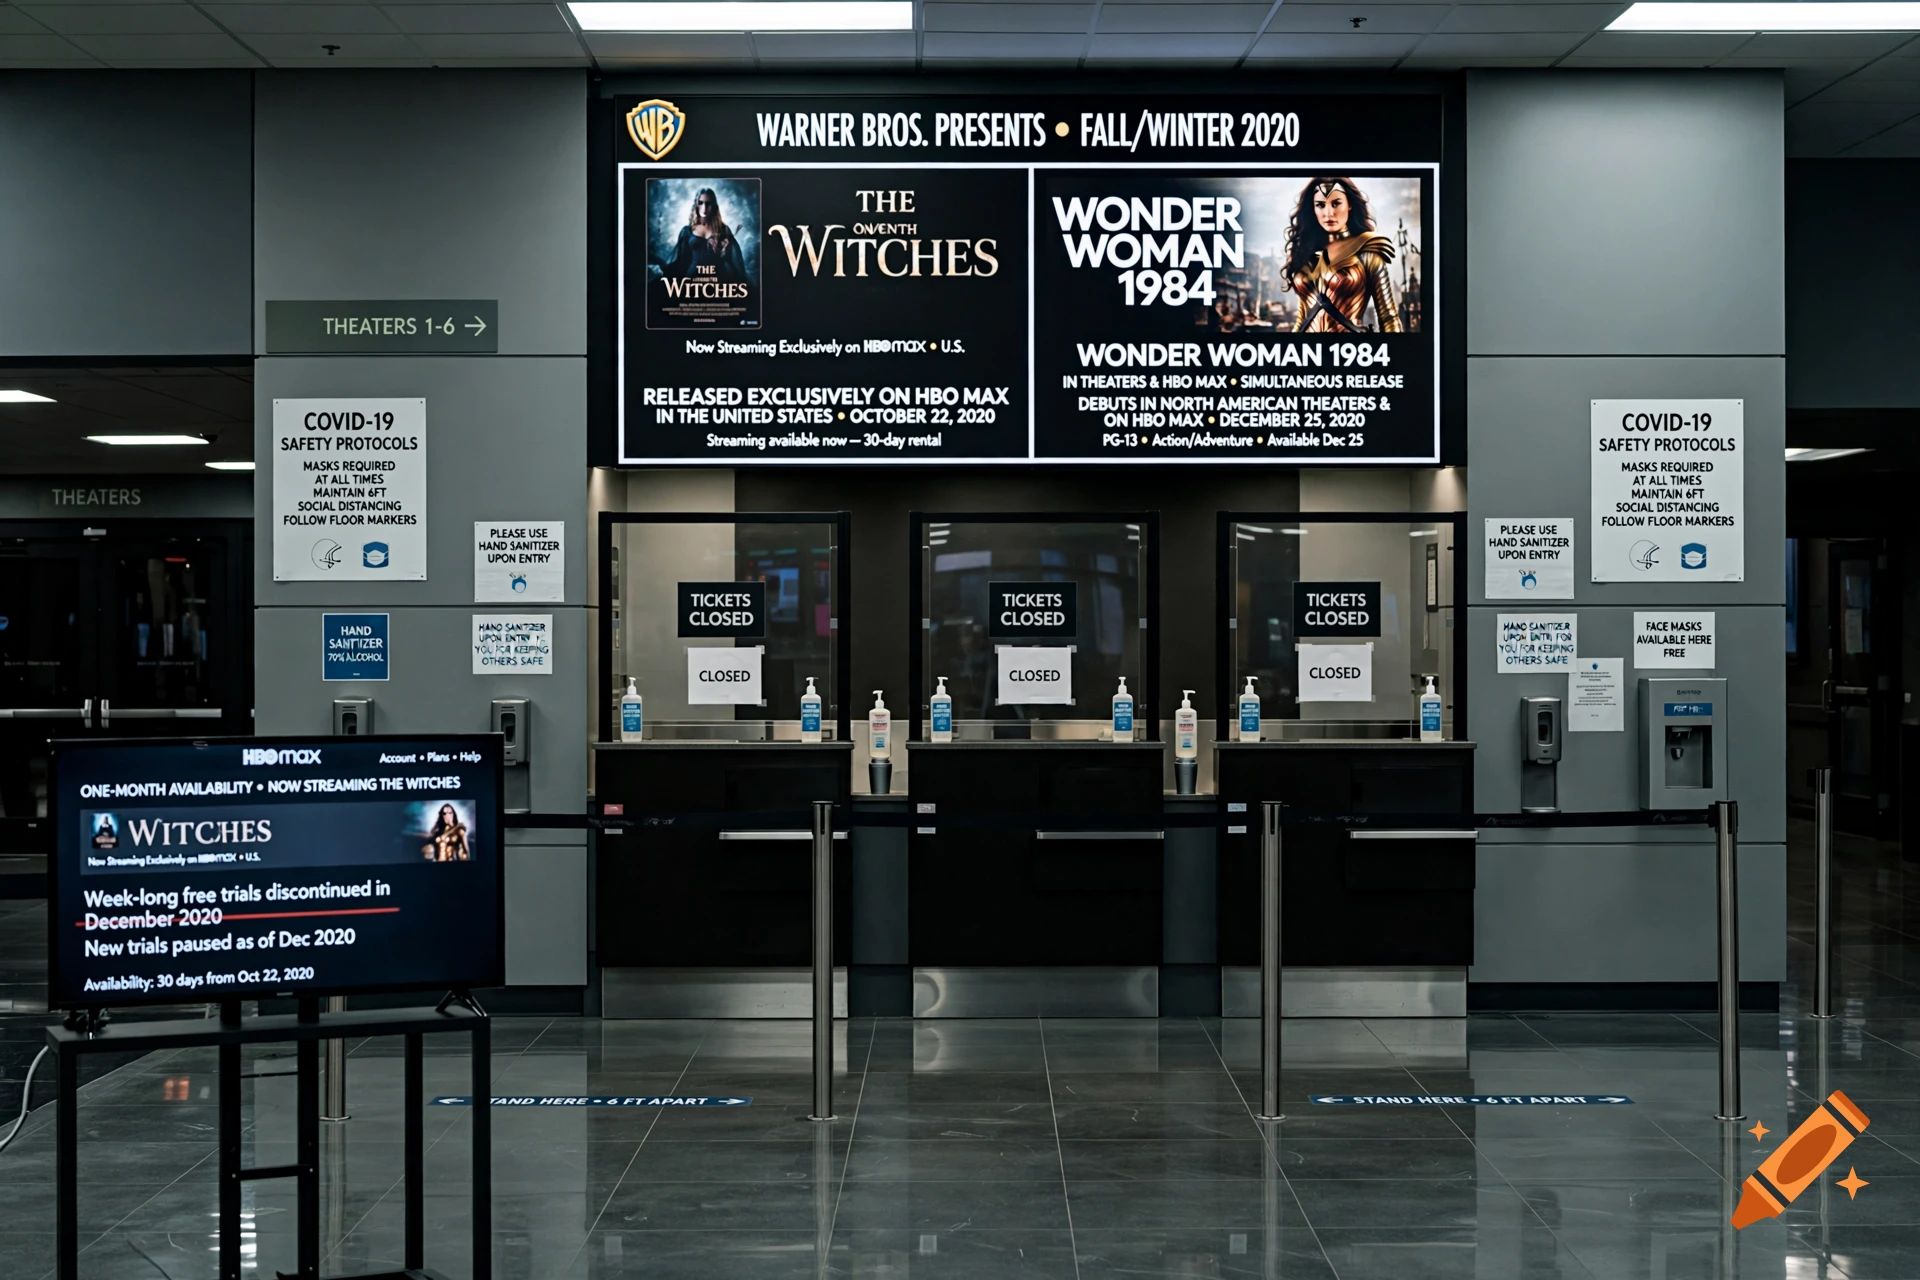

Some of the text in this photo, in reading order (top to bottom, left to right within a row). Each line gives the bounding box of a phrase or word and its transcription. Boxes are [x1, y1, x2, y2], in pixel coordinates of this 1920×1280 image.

[634, 109, 675, 150] WB
[757, 109, 1299, 152] WARNER BROS. PRESENTS FALL/WINTER 2020
[856, 191, 915, 212] THE
[1052, 197, 1243, 231] WONDER
[1064, 233, 1244, 268] WOMAN
[696, 266, 715, 274] THE
[1118, 270, 1216, 306] 1984
[323, 317, 454, 334] THEATERS 1-6
[686, 340, 714, 353] Now
[717, 340, 776, 357] Streaming
[779, 339, 842, 357] Exclusively
[845, 344, 860, 353] on
[941, 340, 965, 353] U.S.
[1063, 375, 1403, 388] IN THEATERS HBO MAX SIMULTANEOUS RELEASE
[1079, 396, 1376, 411] DEBUTS IN NORTH AMERICAN THEATERS
[304, 412, 394, 431] COVID-19
[1104, 413, 1365, 429] ON HBO MAX DECEMBER 25, 2020
[1622, 413, 1711, 431] COVID-19
[281, 437, 417, 451] SAFETY PROTOCOLS
[707, 432, 941, 450] Streaming available now 30-day rental
[1103, 432, 1364, 448] PG-13 Action/Adventure Available Dec 25
[1599, 438, 1735, 451] SAFETY PROTOCOLS
[304, 461, 395, 471] MASKS REQUIRED
[1622, 462, 1713, 472] MASKS REQUIRED
[315, 474, 384, 484] AT ALL TIMES
[1633, 475, 1702, 485] AT ALL TIMES
[52, 489, 141, 505] THEATERS
[314, 488, 387, 497] MAINTAIN 6FT
[1632, 489, 1704, 499] MAINTAIN 6FT
[298, 501, 401, 511] SOCIAL DISTANCING
[1616, 502, 1719, 512] SOCIAL DISTANCING
[284, 515, 416, 525] FOLLOW FLOOR MARKERS
[1602, 516, 1734, 526] FOLLOW FLOOR MARKERS
[491, 529, 548, 538] PLEASE USE
[1501, 525, 1557, 535] PLEASE USE
[479, 541, 559, 550] HAND SANITIZER
[1489, 538, 1569, 547] HAND SANITIZER
[488, 554, 550, 563] UPON ENTRY
[1499, 550, 1560, 559] UPON ENTRY
[691, 594, 751, 607] TICKETS
[1002, 594, 1062, 607] TICKETS
[1307, 593, 1366, 606] TICKETS
[689, 612, 753, 626] CLOSED
[1001, 612, 1065, 626] CLOSED
[1305, 611, 1369, 625] CLOSED
[340, 625, 372, 636] HAND
[1647, 622, 1702, 631] FACE MASKS
[1637, 635, 1711, 644] AVAILABLE HERE
[1664, 649, 1685, 657] FREE
[520, 657, 544, 665] SAFE
[699, 670, 750, 682] CLOSED
[1009, 670, 1060, 681] CLOSED
[1310, 667, 1360, 679] CLOSED
[379, 751, 481, 763] Account Plans Help
[80, 776, 460, 798] ONE-MONTH AVAILABILITY NOW STREAMING THE WITCHES
[84, 880, 390, 910] Week-long free trials discontinued in
[85, 908, 223, 931] December 2020
[85, 928, 355, 957] New trials paused as of Dec 2020
[84, 967, 314, 992] Availability: 30 days from Oct 22, 2020
[489, 1097, 535, 1105] TAND
[539, 1097, 589, 1105] HERE
[622, 1097, 645, 1106] FT
[648, 1097, 709, 1105] APART
[1353, 1096, 1587, 1105] STAND HERE 6 FT APART
